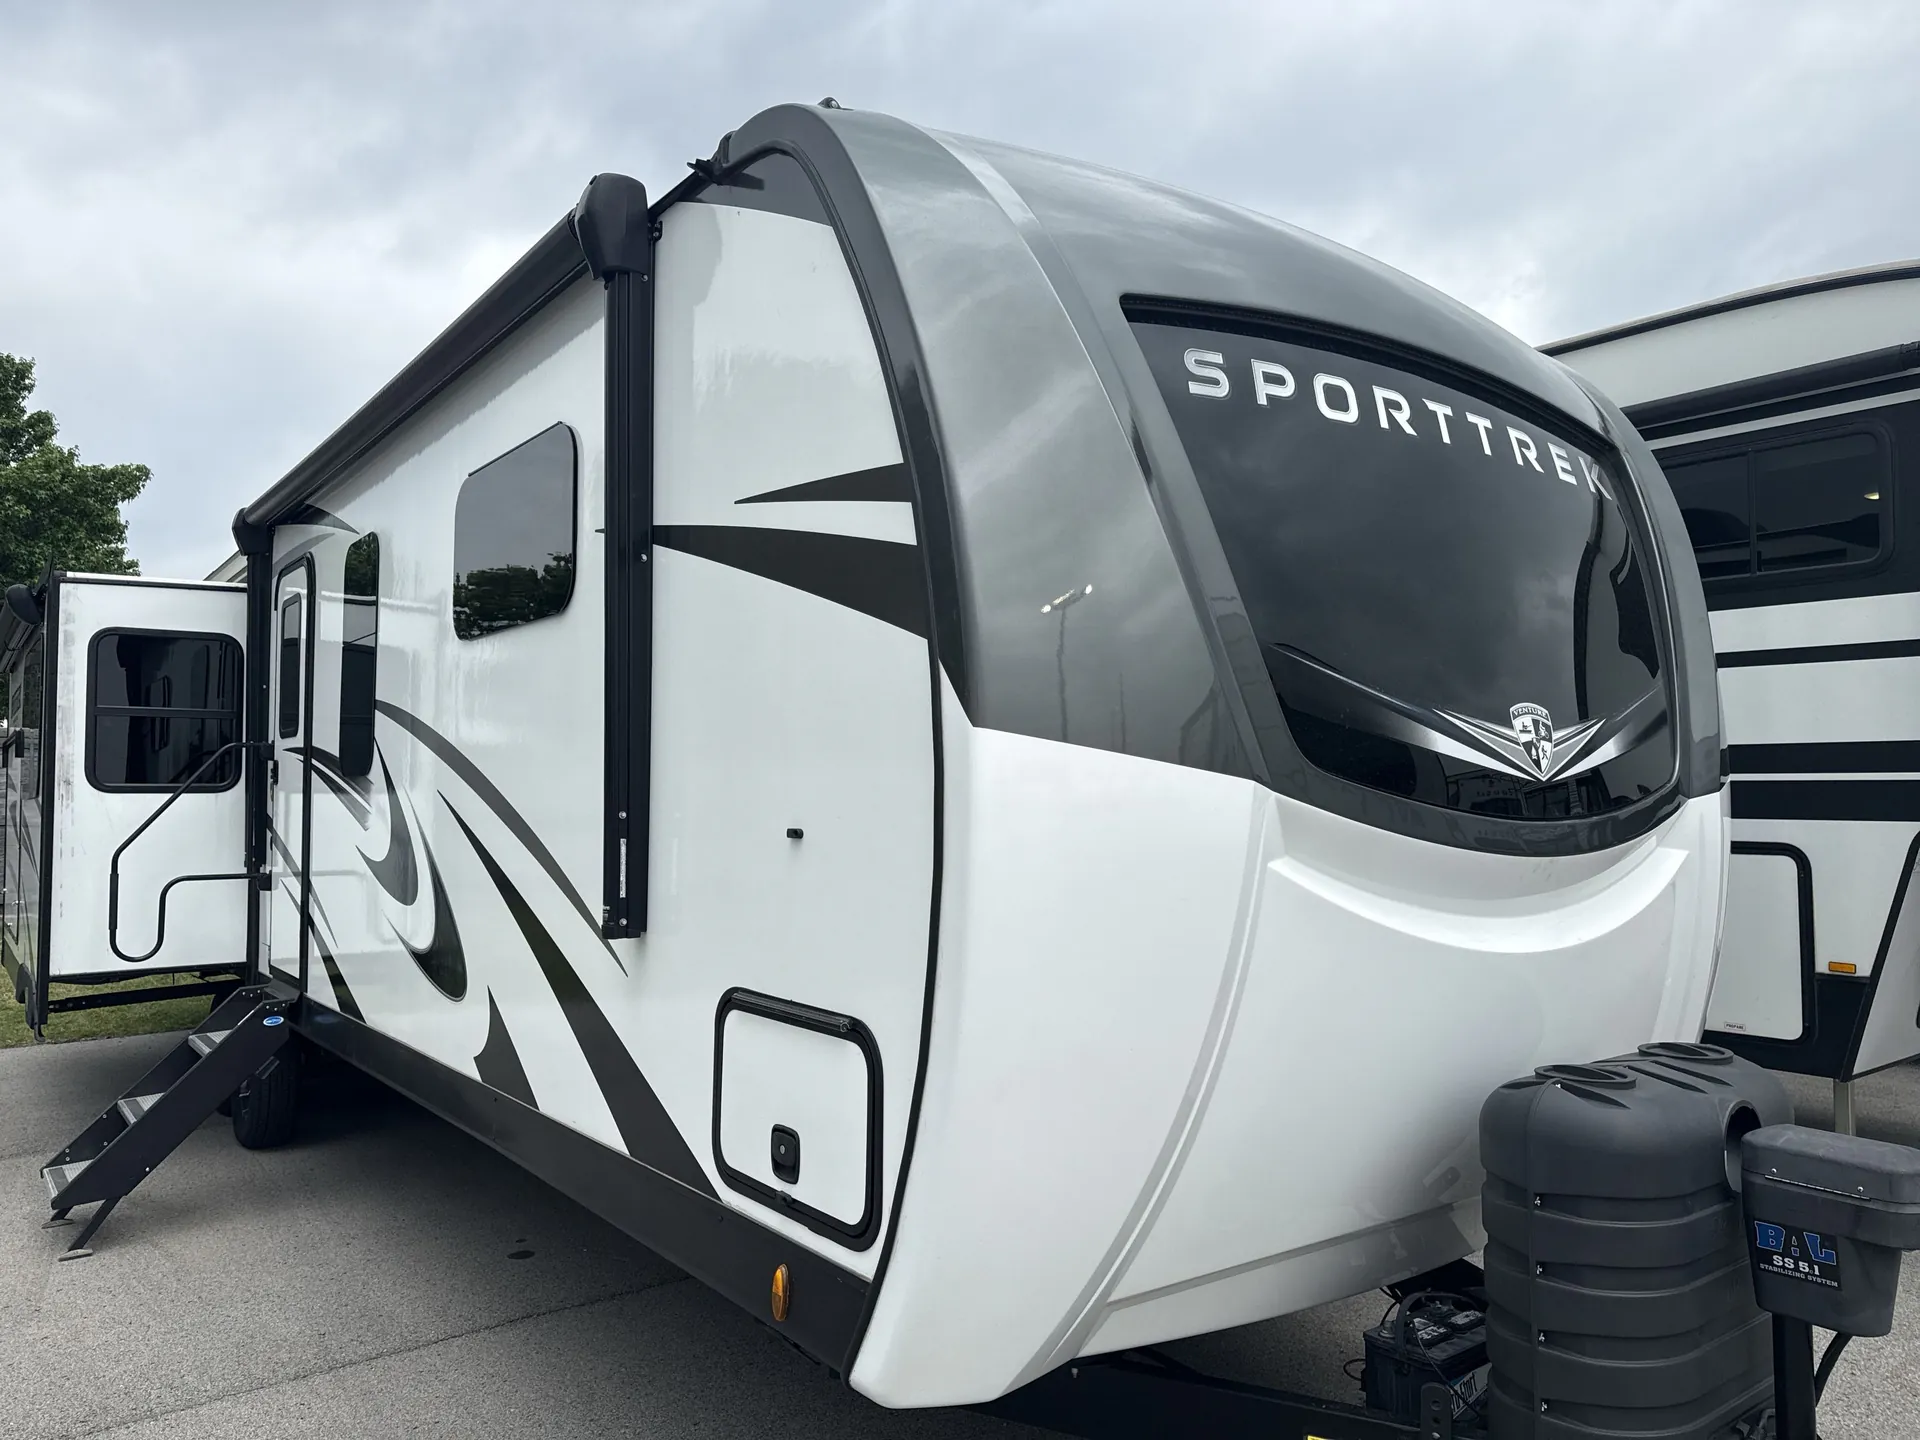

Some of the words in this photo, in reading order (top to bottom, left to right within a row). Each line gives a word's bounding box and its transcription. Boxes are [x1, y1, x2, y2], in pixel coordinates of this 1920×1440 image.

[1183, 347, 1612, 501] SPORTTREK
[1513, 706, 1548, 719] VENTURE
[1759, 1263, 1806, 1280] STABILIZING
[1807, 1274, 1839, 1288] SYSTEM
[1772, 1255, 1795, 1270] SS
[1798, 1261, 1820, 1276] 5.1
